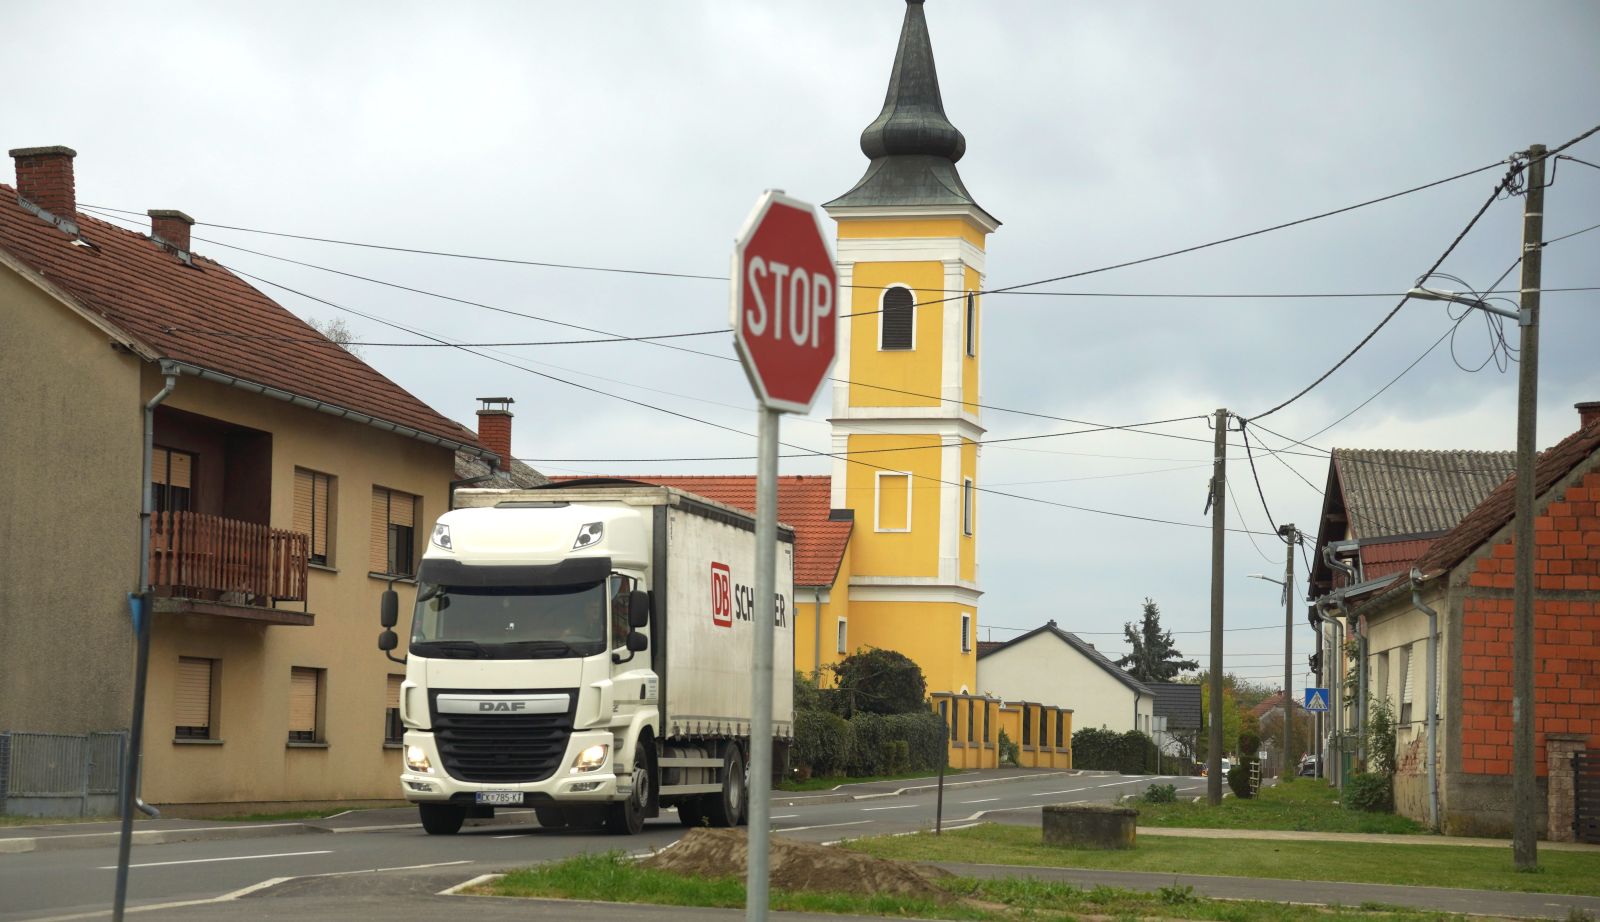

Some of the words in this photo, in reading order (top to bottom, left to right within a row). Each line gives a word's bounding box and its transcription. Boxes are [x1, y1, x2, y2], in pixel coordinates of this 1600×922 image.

[746, 256, 832, 348] STOP
[713, 572, 729, 617] DB
[735, 583, 786, 628] SCHER
[479, 702, 526, 712] DAF
